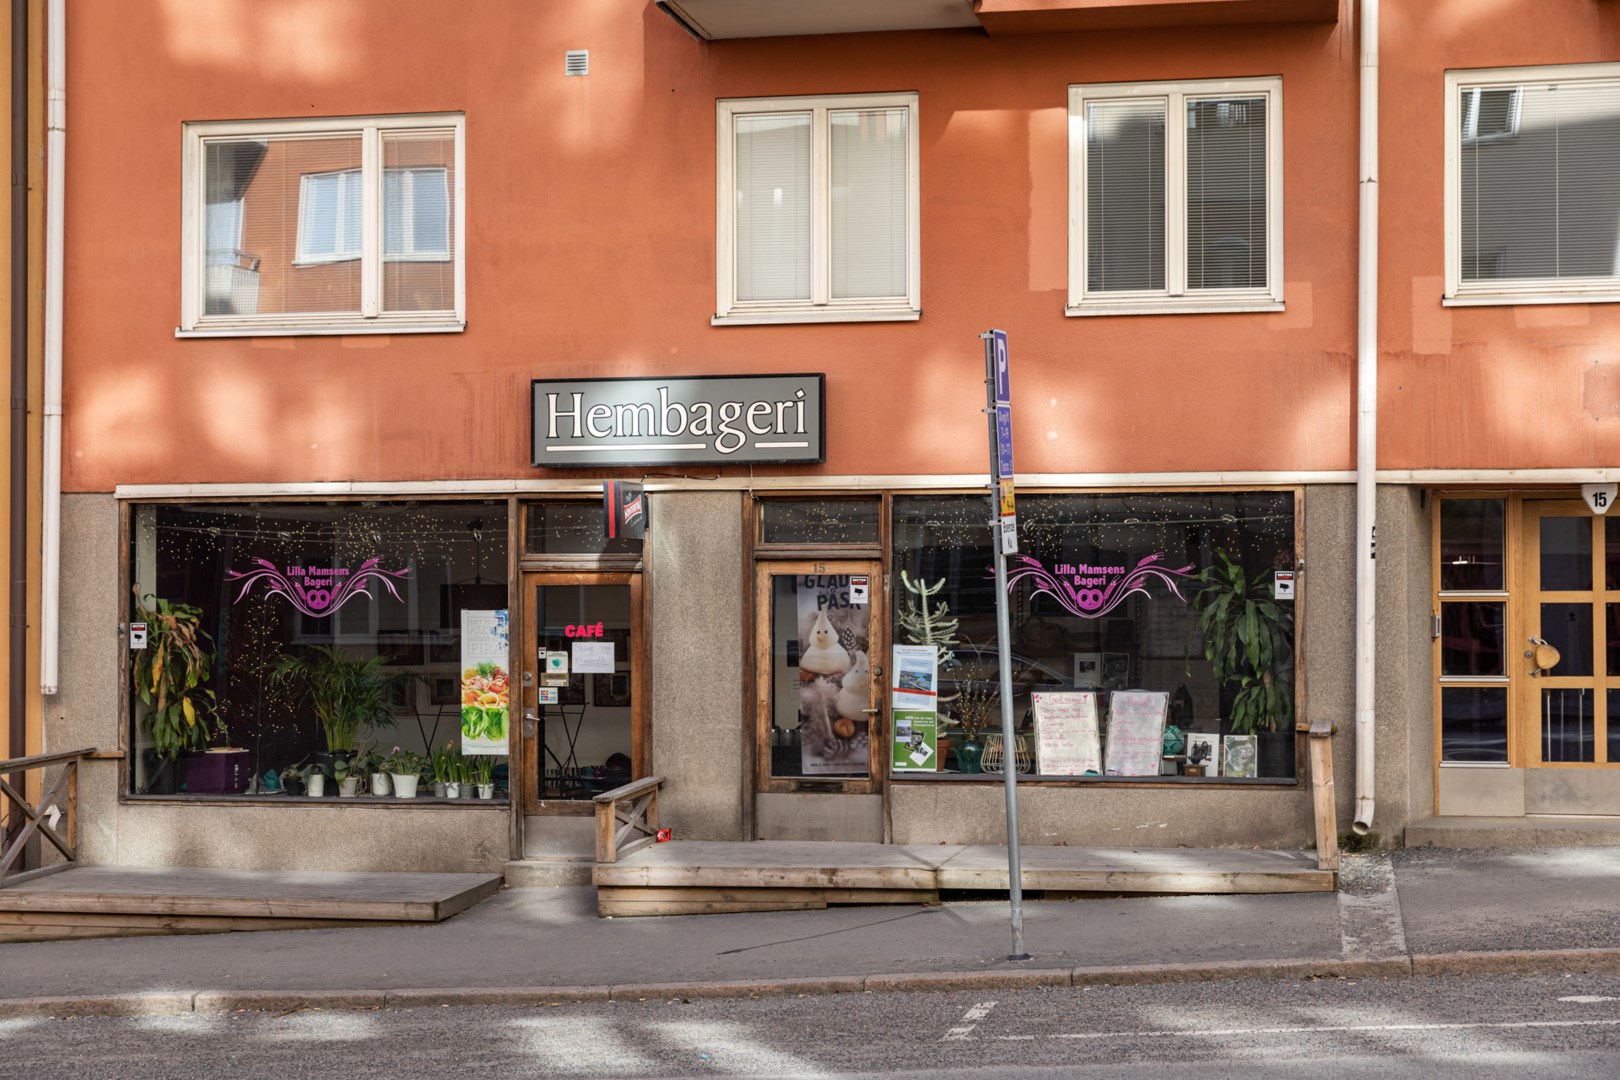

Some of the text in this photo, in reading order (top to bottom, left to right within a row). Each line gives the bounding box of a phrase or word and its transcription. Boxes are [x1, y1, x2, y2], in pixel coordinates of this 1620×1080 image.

[997, 338, 1006, 395] P
[545, 386, 809, 454] Hembageri
[1592, 492, 1607, 507] 15
[287, 566, 349, 576] Lilla Mamsens
[813, 563, 825, 573] 15
[1054, 564, 1125, 574] Lilla Mamsens
[304, 576, 332, 589] Bageri
[804, 574, 850, 589] GLAD
[1074, 575, 1106, 588] Bageri
[565, 621, 604, 637] CAFÉ
